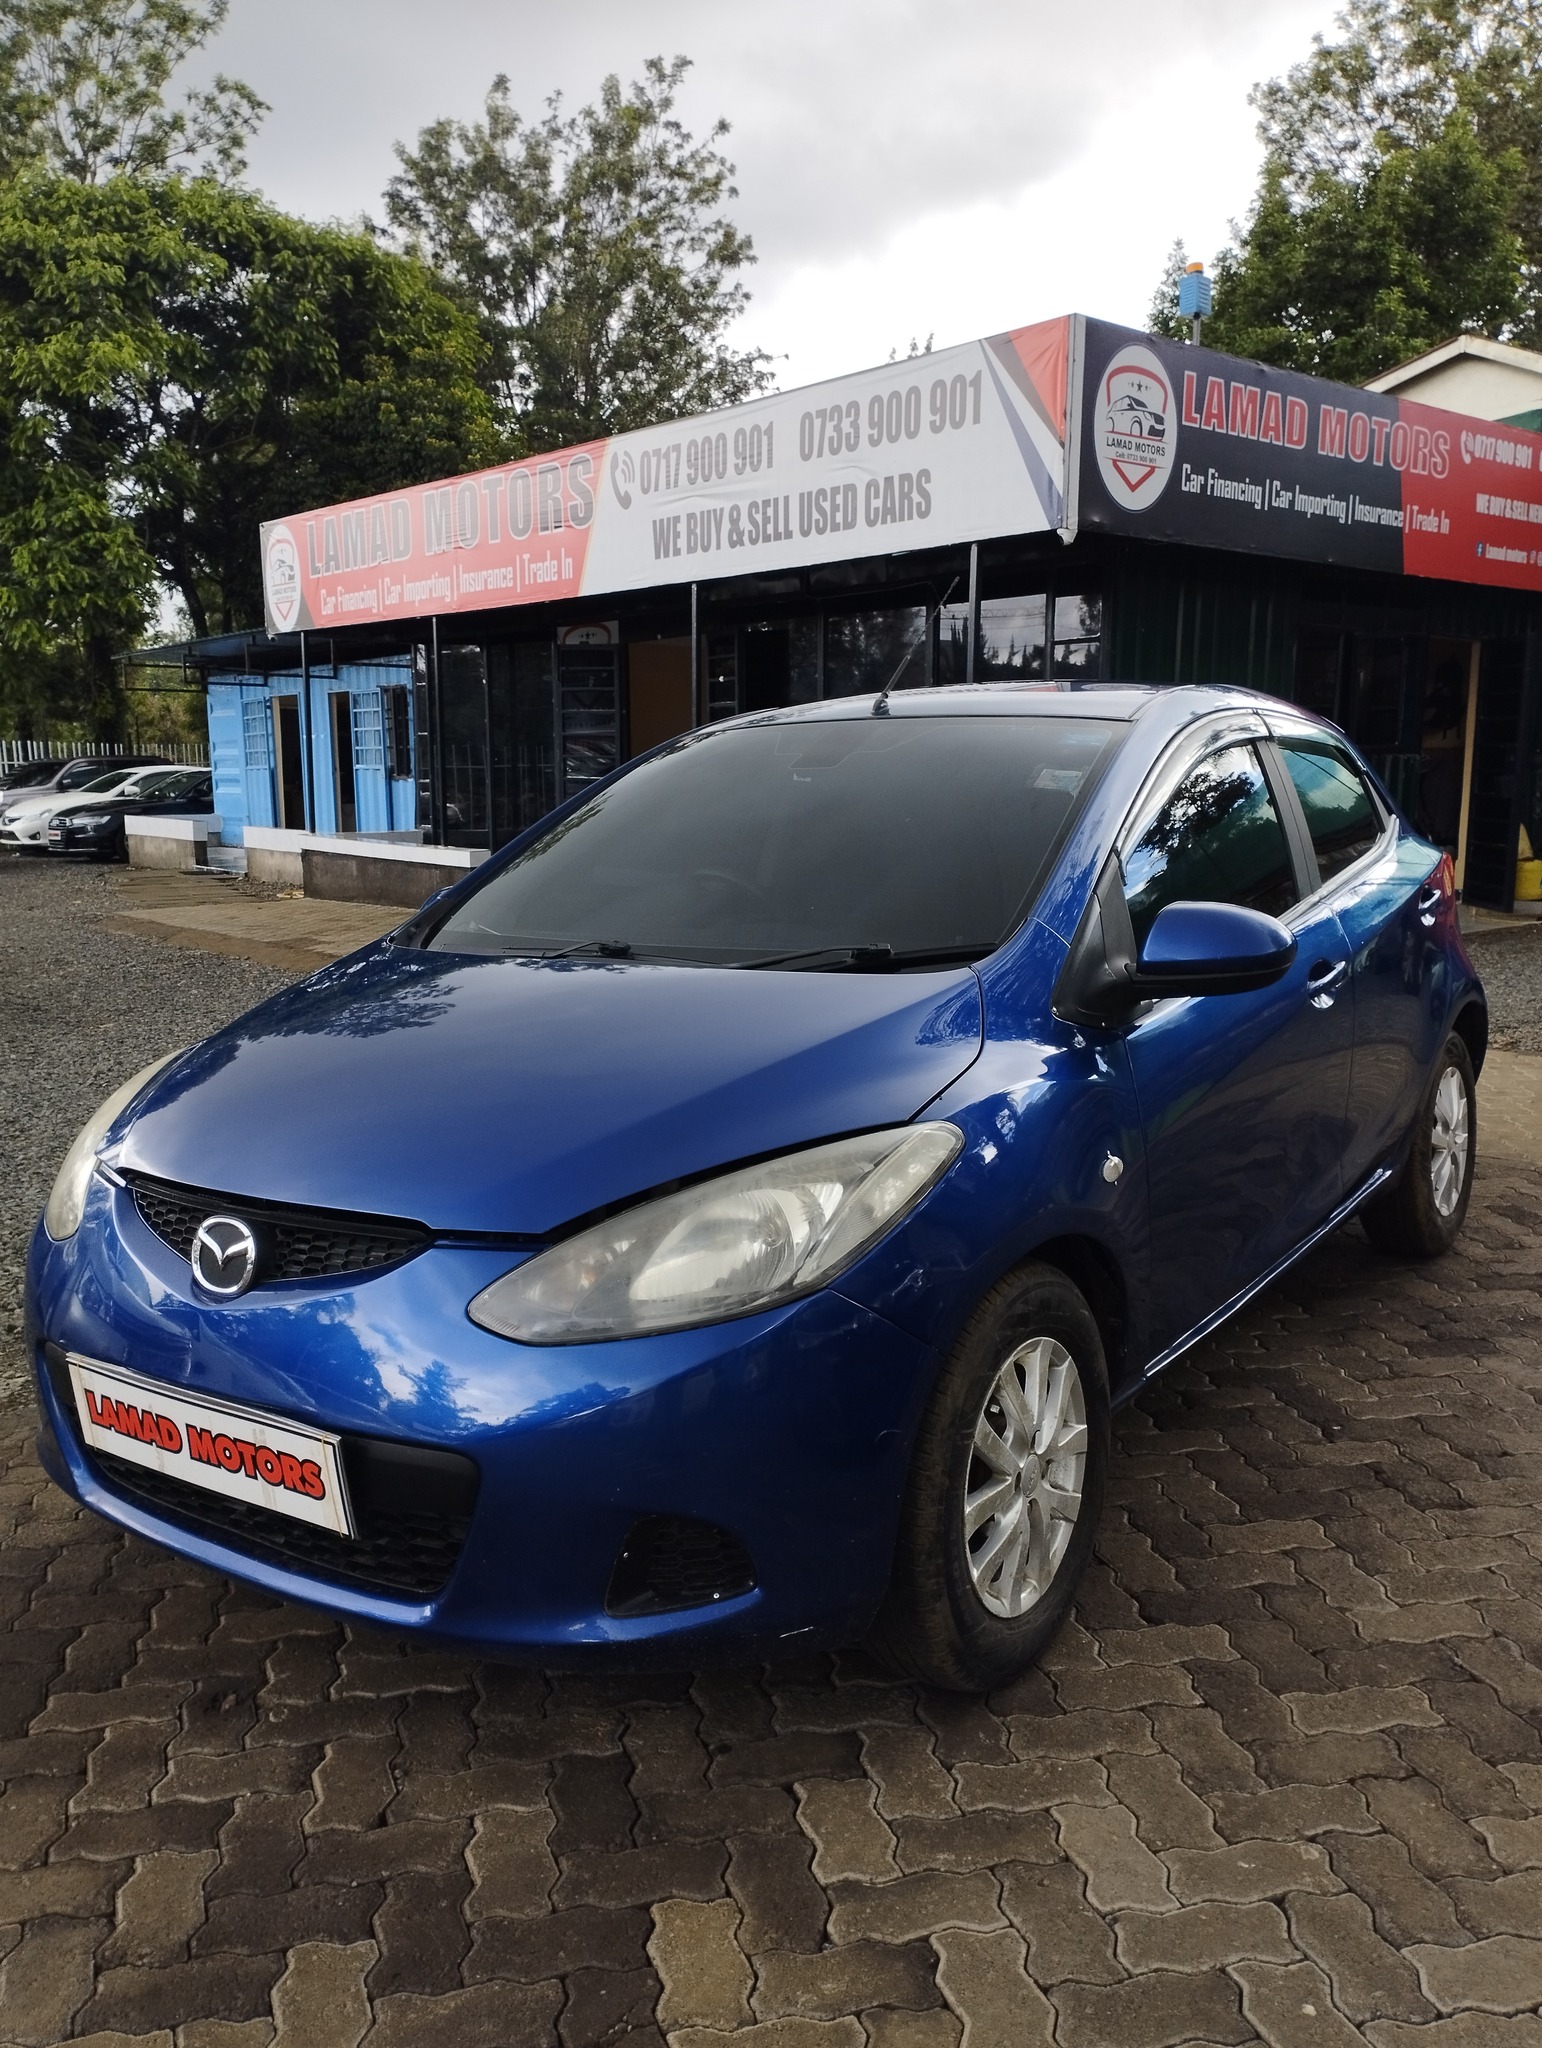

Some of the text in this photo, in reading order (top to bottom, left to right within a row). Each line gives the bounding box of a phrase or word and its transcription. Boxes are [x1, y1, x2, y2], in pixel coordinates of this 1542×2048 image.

[640, 369, 982, 495] 0717 900 901 0733 900 901
[1106, 436, 1166, 456] LAMAD MOTORS
[1181, 370, 1450, 479] LAMAD MOTORS
[306, 453, 595, 578] LAMAD MOTORS
[652, 469, 932, 560] WE BUY & SELL USED CARS
[1182, 463, 1204, 494] Car
[1207, 467, 1263, 510] Financing
[1272, 479, 1292, 509] Car
[1295, 484, 1347, 524] Importing
[1355, 495, 1404, 527] Insurance
[1412, 505, 1439, 533] Trade
[1440, 510, 1450, 534] In
[321, 589, 336, 615] Car
[337, 586, 378, 613] Financing
[384, 577, 401, 605] Car
[403, 572, 451, 607] Importing
[460, 564, 513, 593] Insurance
[523, 550, 558, 585] Trade
[561, 547, 573, 579] In
[84, 1388, 326, 1500] LAMAD MOTORS
